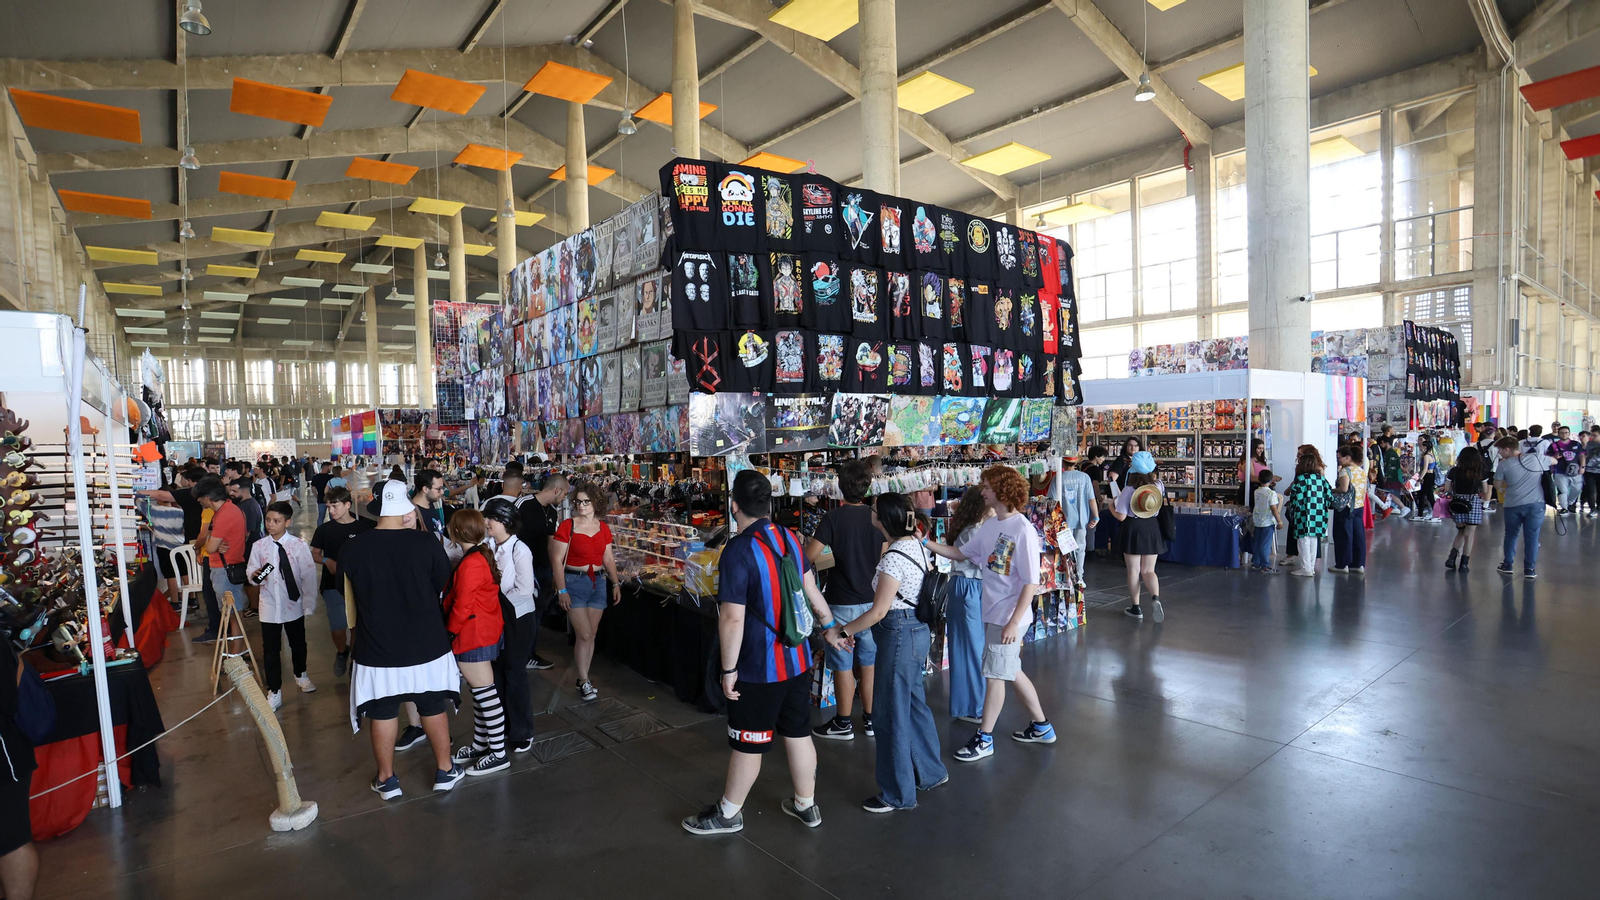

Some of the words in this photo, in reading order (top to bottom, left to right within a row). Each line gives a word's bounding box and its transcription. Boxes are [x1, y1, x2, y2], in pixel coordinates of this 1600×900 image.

[697, 187, 707, 195] ME
[632, 197, 657, 217] WANTED
[721, 205, 755, 213] GONNA
[722, 211, 756, 226] DIE
[638, 319, 657, 330] SHANKS
[743, 731, 772, 742] CHILL.
